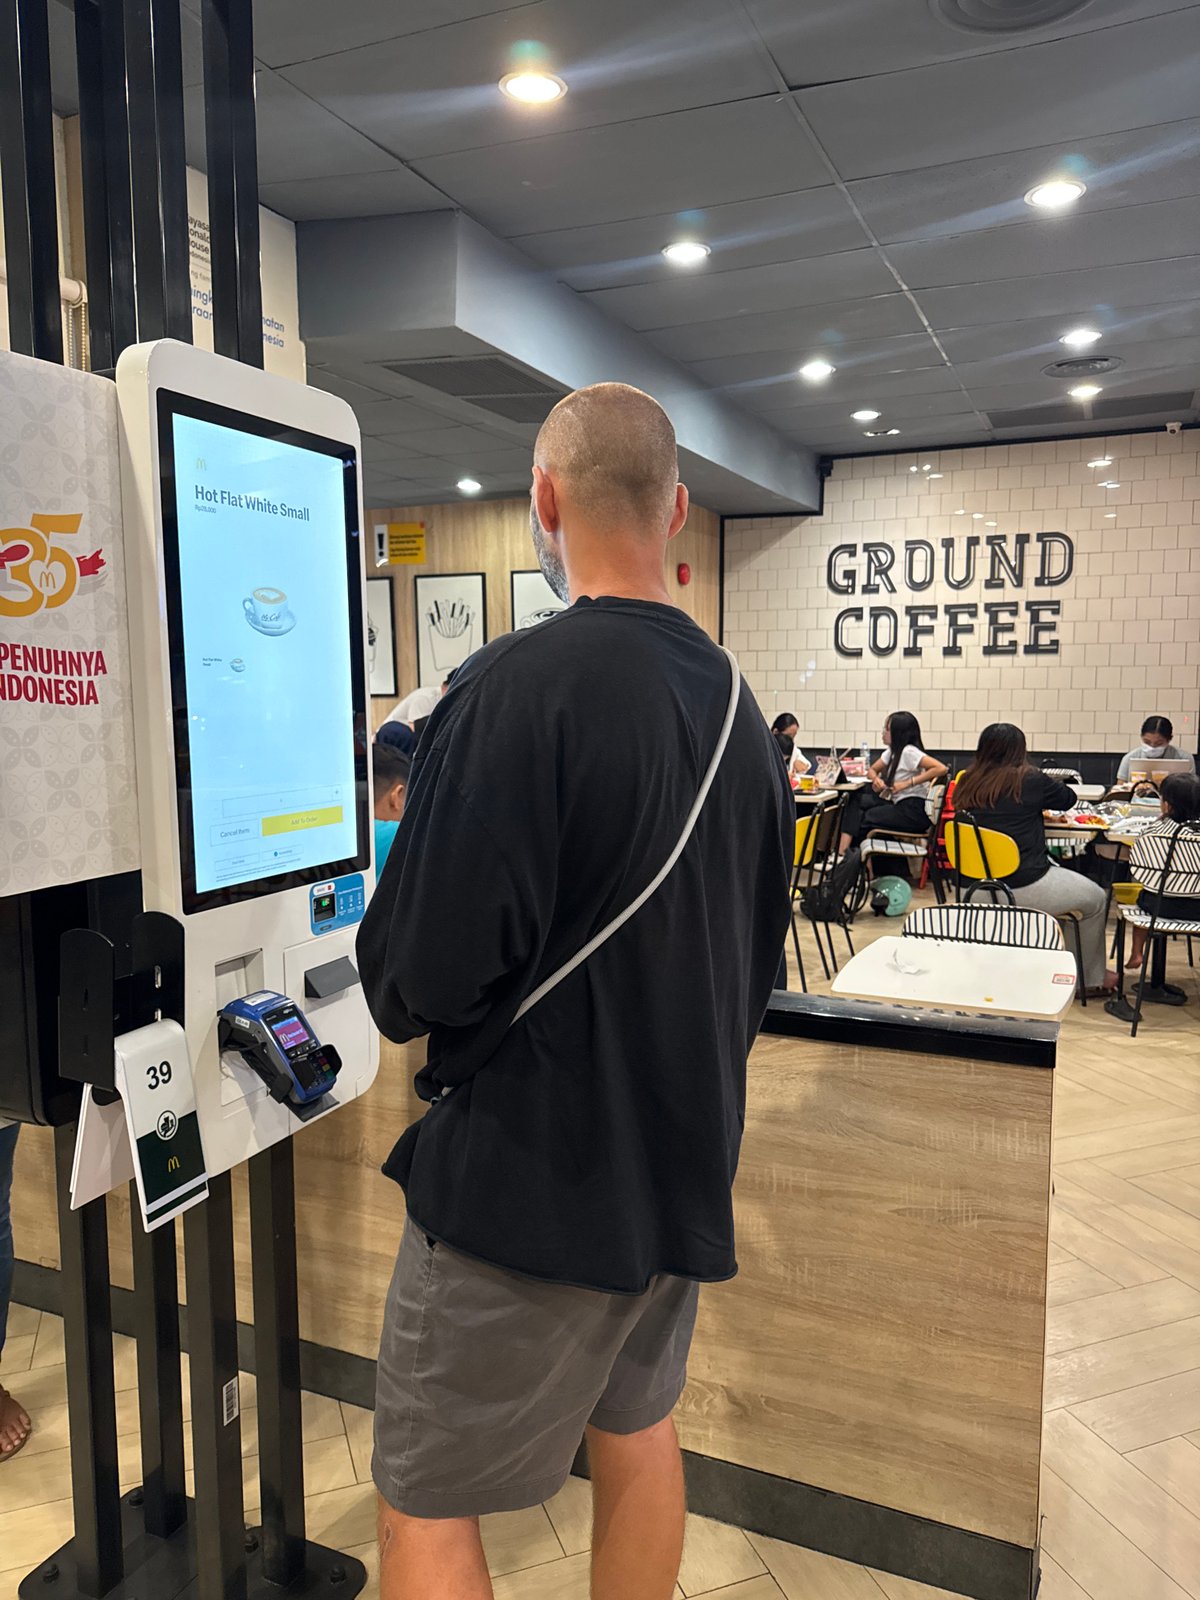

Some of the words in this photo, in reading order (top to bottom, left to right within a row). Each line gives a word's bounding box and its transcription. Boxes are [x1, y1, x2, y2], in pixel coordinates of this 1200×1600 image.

[195, 484, 218, 503] Hot
[220, 490, 244, 508] Flat
[244, 494, 279, 515] White
[280, 503, 310, 522] Small
[826, 531, 1075, 596] GROUND
[833, 599, 1062, 658] COFFEE
[146, 1060, 172, 1090] 39
